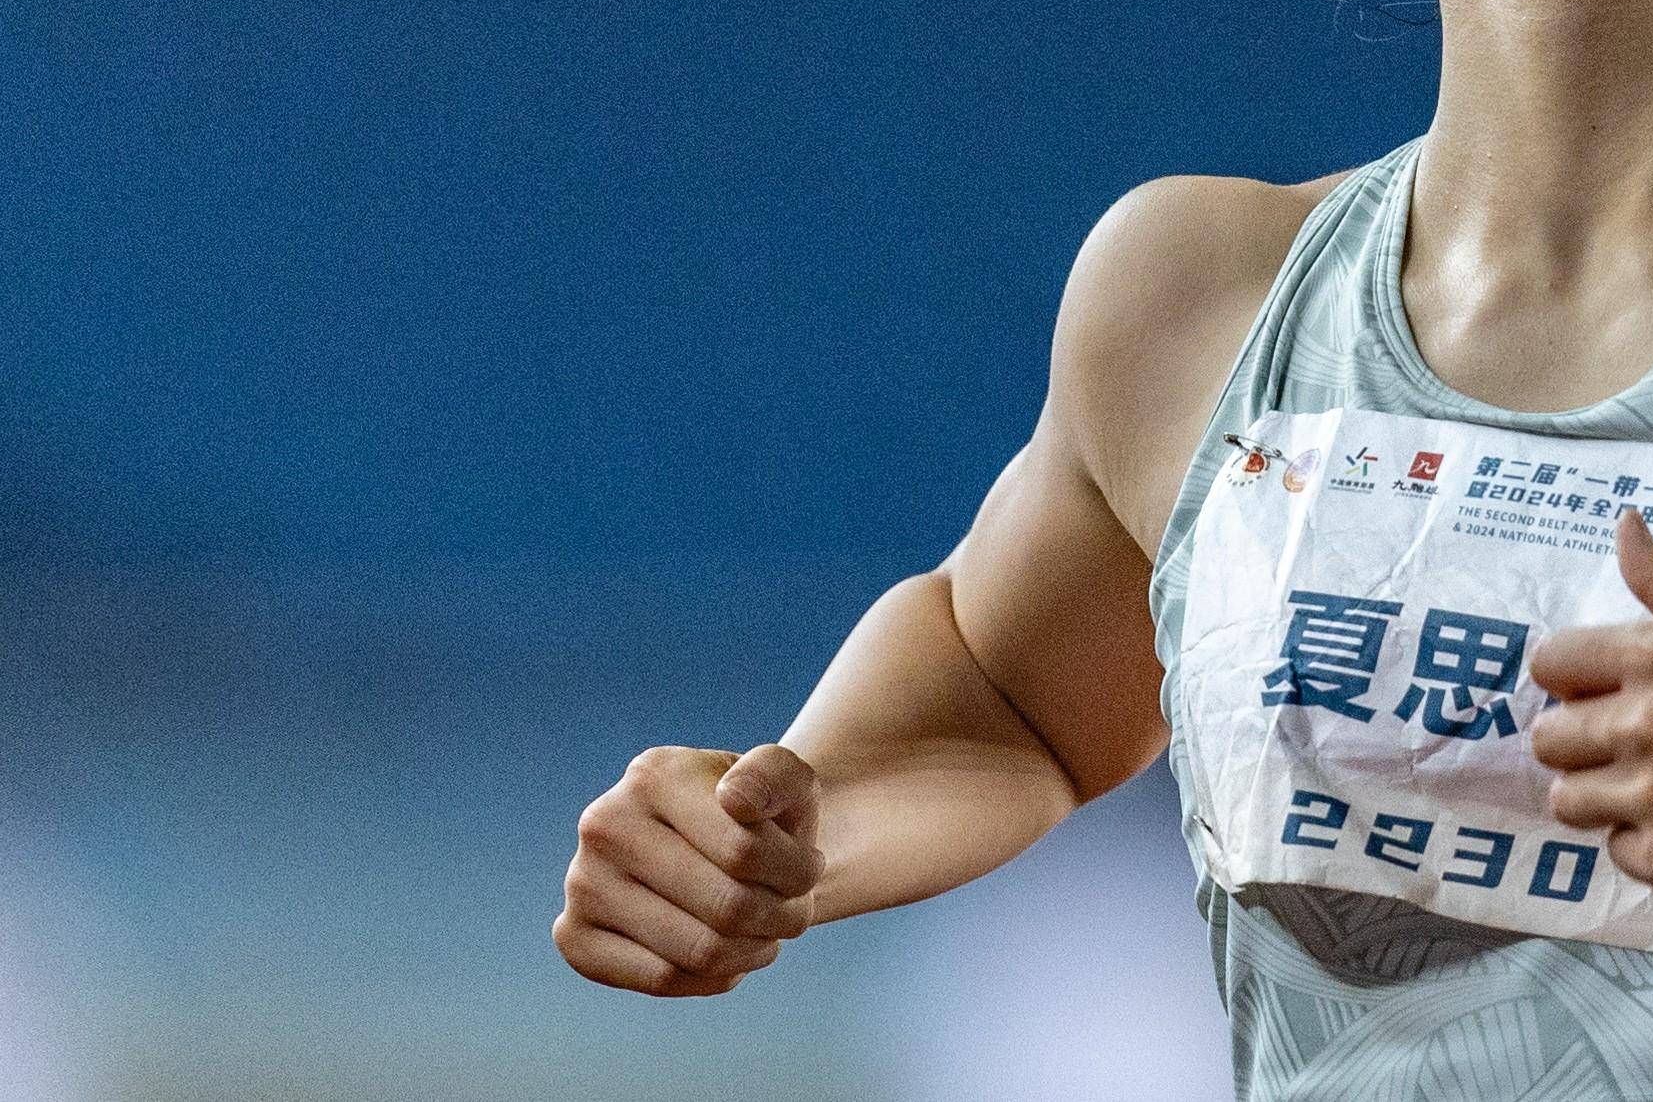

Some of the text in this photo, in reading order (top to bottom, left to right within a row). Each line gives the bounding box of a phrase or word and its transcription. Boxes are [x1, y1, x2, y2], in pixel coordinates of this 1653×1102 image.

[1453, 522, 1462, 533] &
[1466, 524, 1496, 538] 2024
[1499, 529, 1559, 547] NATIONAL
[1458, 505, 1481, 518] THE
[1484, 509, 1535, 526] SECOND
[1539, 517, 1568, 531] BELT
[1571, 523, 1598, 536] AND
[1261, 590, 1558, 740] 夏思
[1281, 790, 1600, 902] 2230
